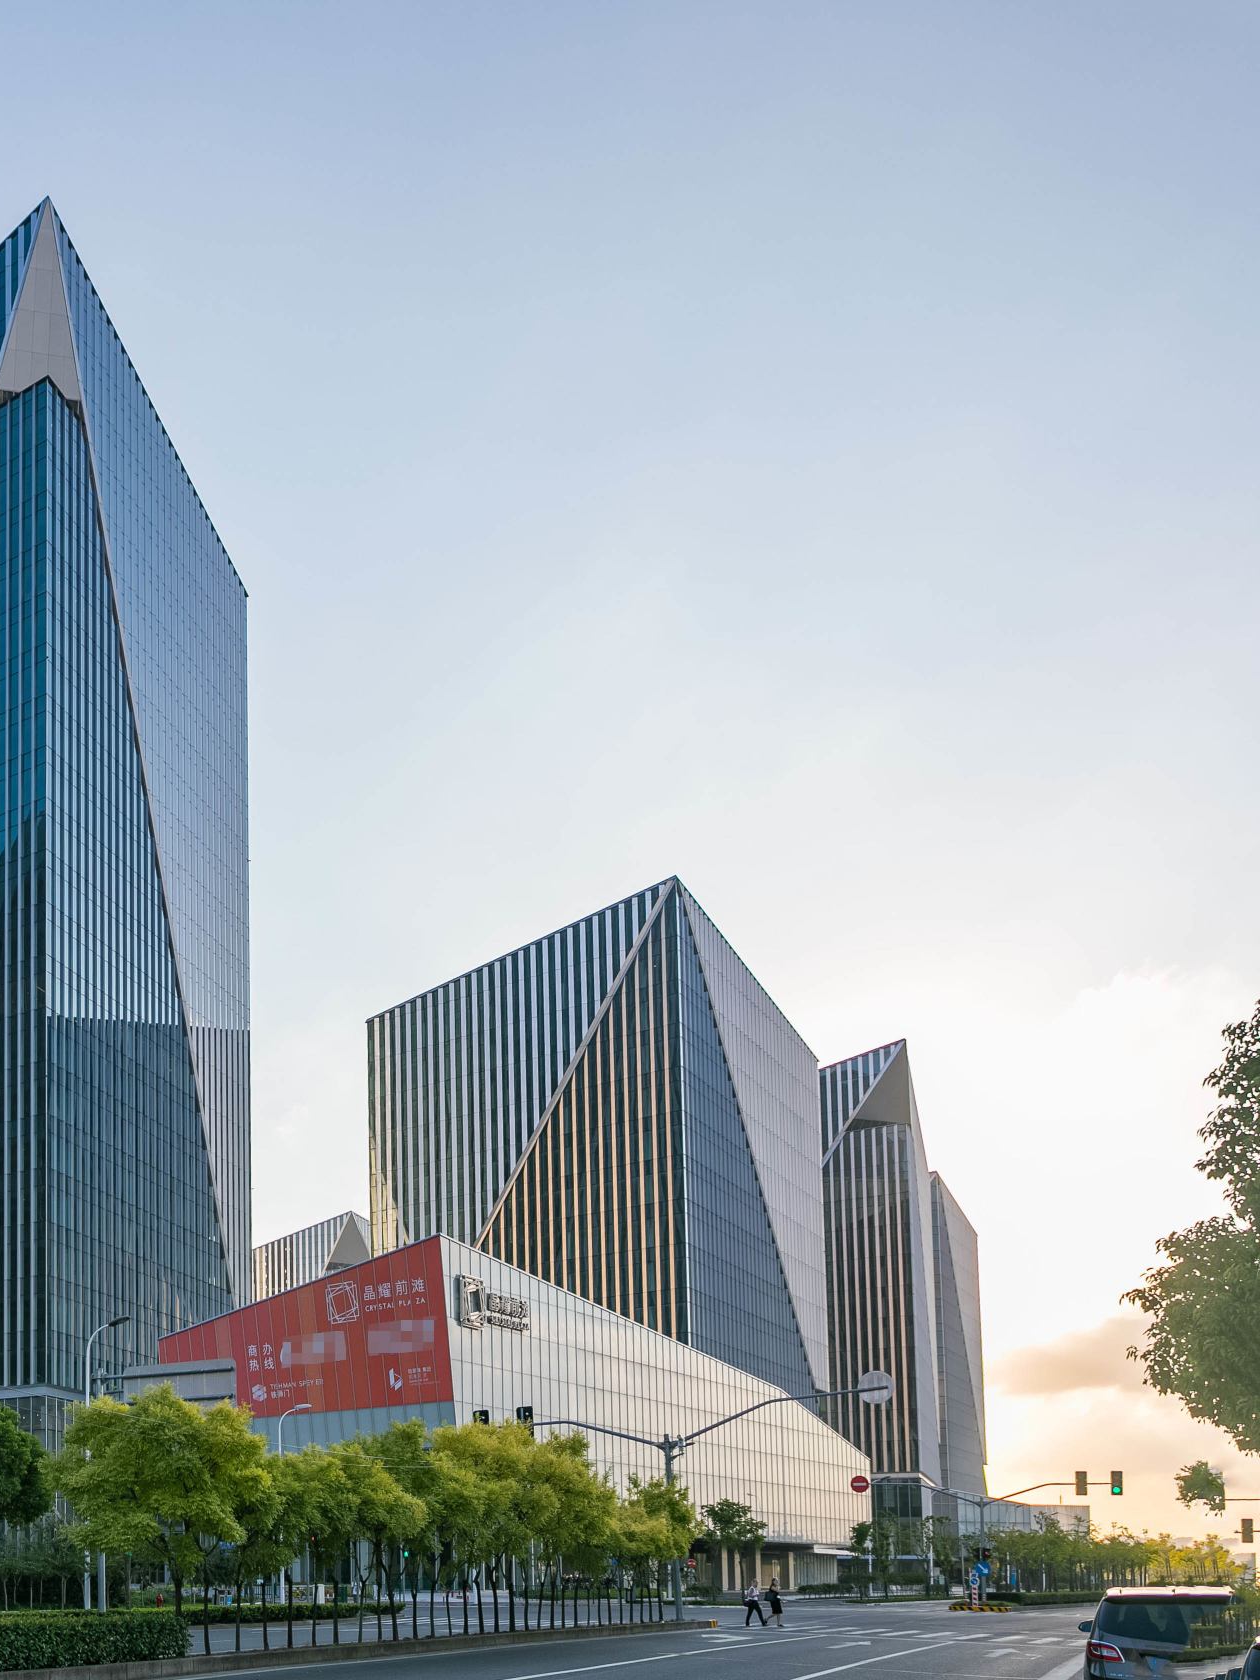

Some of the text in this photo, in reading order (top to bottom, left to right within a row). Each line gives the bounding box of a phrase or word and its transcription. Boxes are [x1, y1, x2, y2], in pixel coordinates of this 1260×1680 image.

[363, 1277, 426, 1301] 晶耀前滩
[364, 1302, 395, 1312] CRYSTAL
